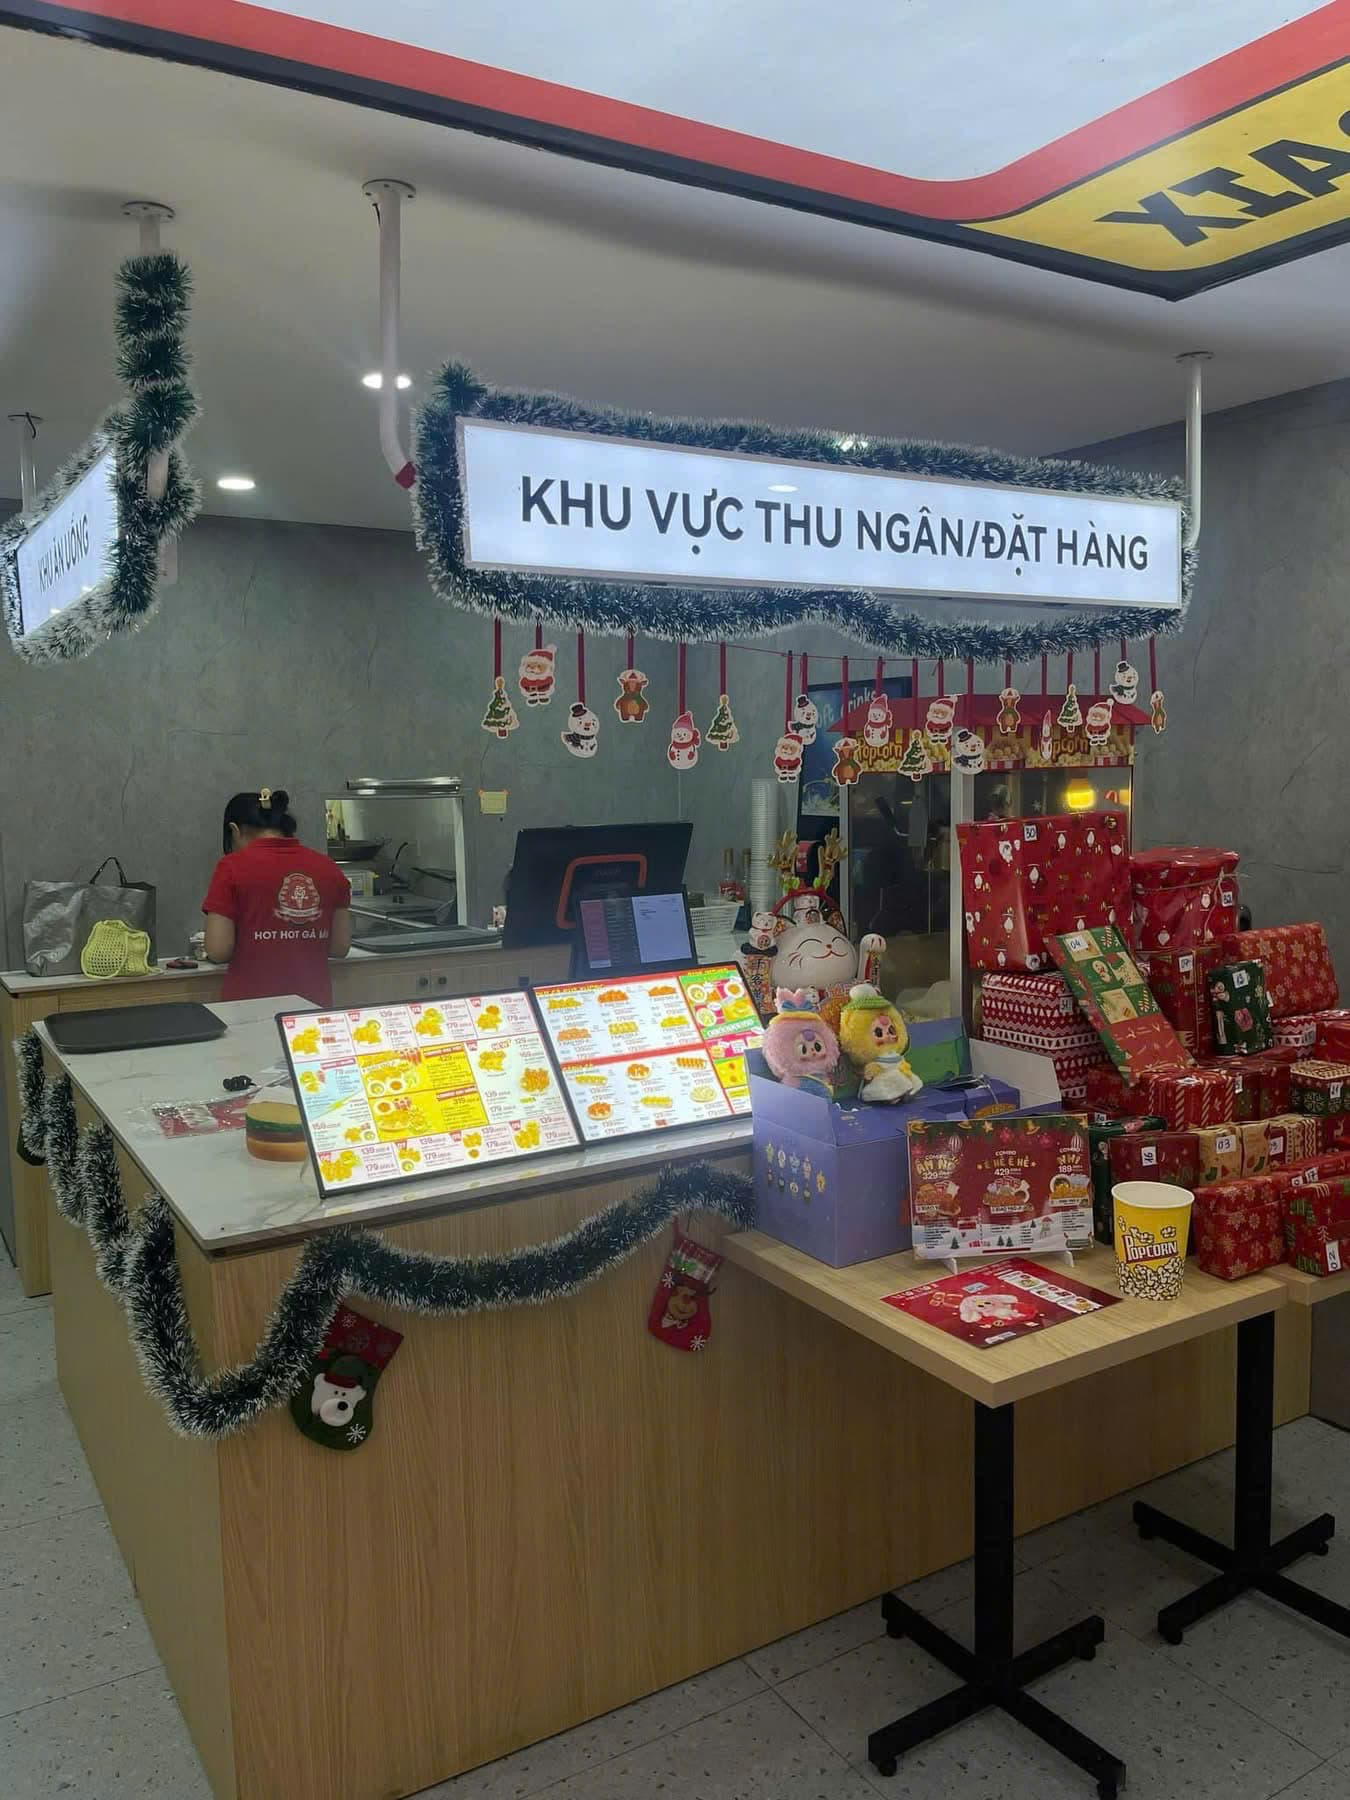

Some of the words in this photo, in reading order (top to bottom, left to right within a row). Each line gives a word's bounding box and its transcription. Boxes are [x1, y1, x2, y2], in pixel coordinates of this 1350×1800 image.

[1093, 110, 1350, 247] XIA
[522, 475, 631, 531] KHU
[645, 488, 744, 555] VỰC
[755, 500, 842, 548] THU
[857, 506, 1047, 577] NGÂN/ĐẶT
[1057, 520, 1148, 571] HÀNG
[38, 547, 53, 593] KHU
[1051, 734, 1089, 762] pcorn
[254, 930, 277, 940] HOT
[280, 930, 300, 939] HOT
[1217, 1139, 1231, 1150] 03
[1124, 1234, 1177, 1261] POPCORN
